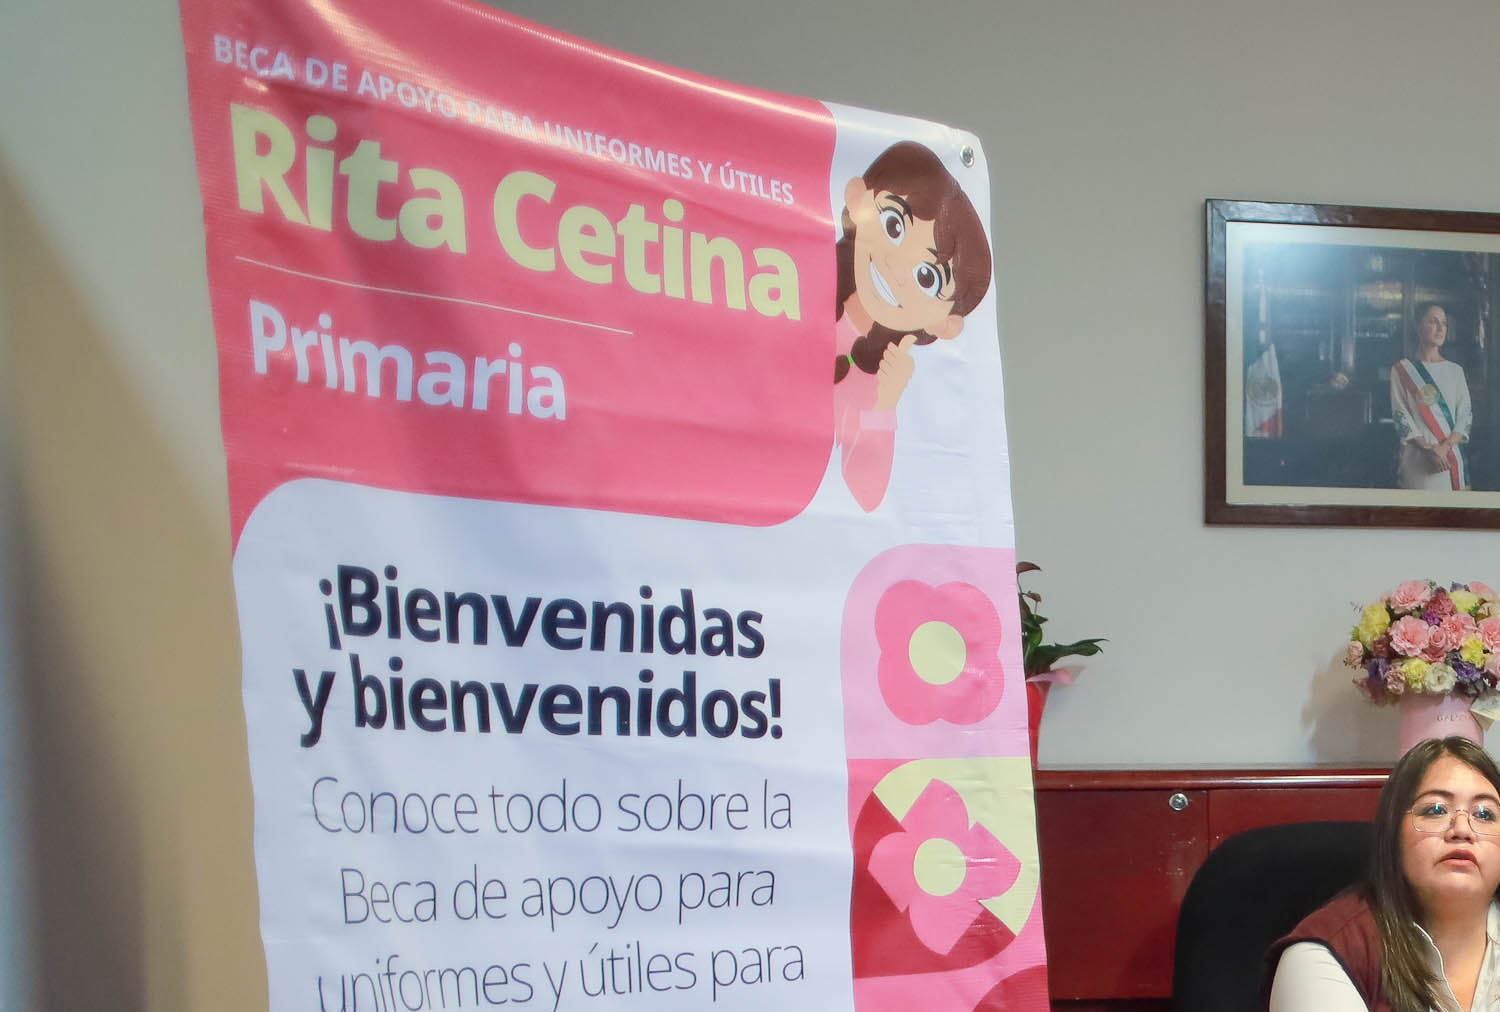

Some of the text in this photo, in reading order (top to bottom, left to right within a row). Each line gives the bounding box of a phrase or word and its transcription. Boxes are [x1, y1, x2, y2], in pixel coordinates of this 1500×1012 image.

[213, 35, 794, 205] BECA DE APOYO PARA UNIFORMES Y ÚTILES
[230, 102, 801, 321] Rita Cetina
[248, 299, 566, 422] Primaria
[318, 564, 764, 658] ¡Bienvenidas
[292, 653, 783, 747] y bienvenidos!
[311, 776, 793, 836] Conoce todo sobre la
[340, 863, 776, 932] Beca de apoyo para
[579, 941, 698, 998] útiles
[709, 943, 806, 1001] para
